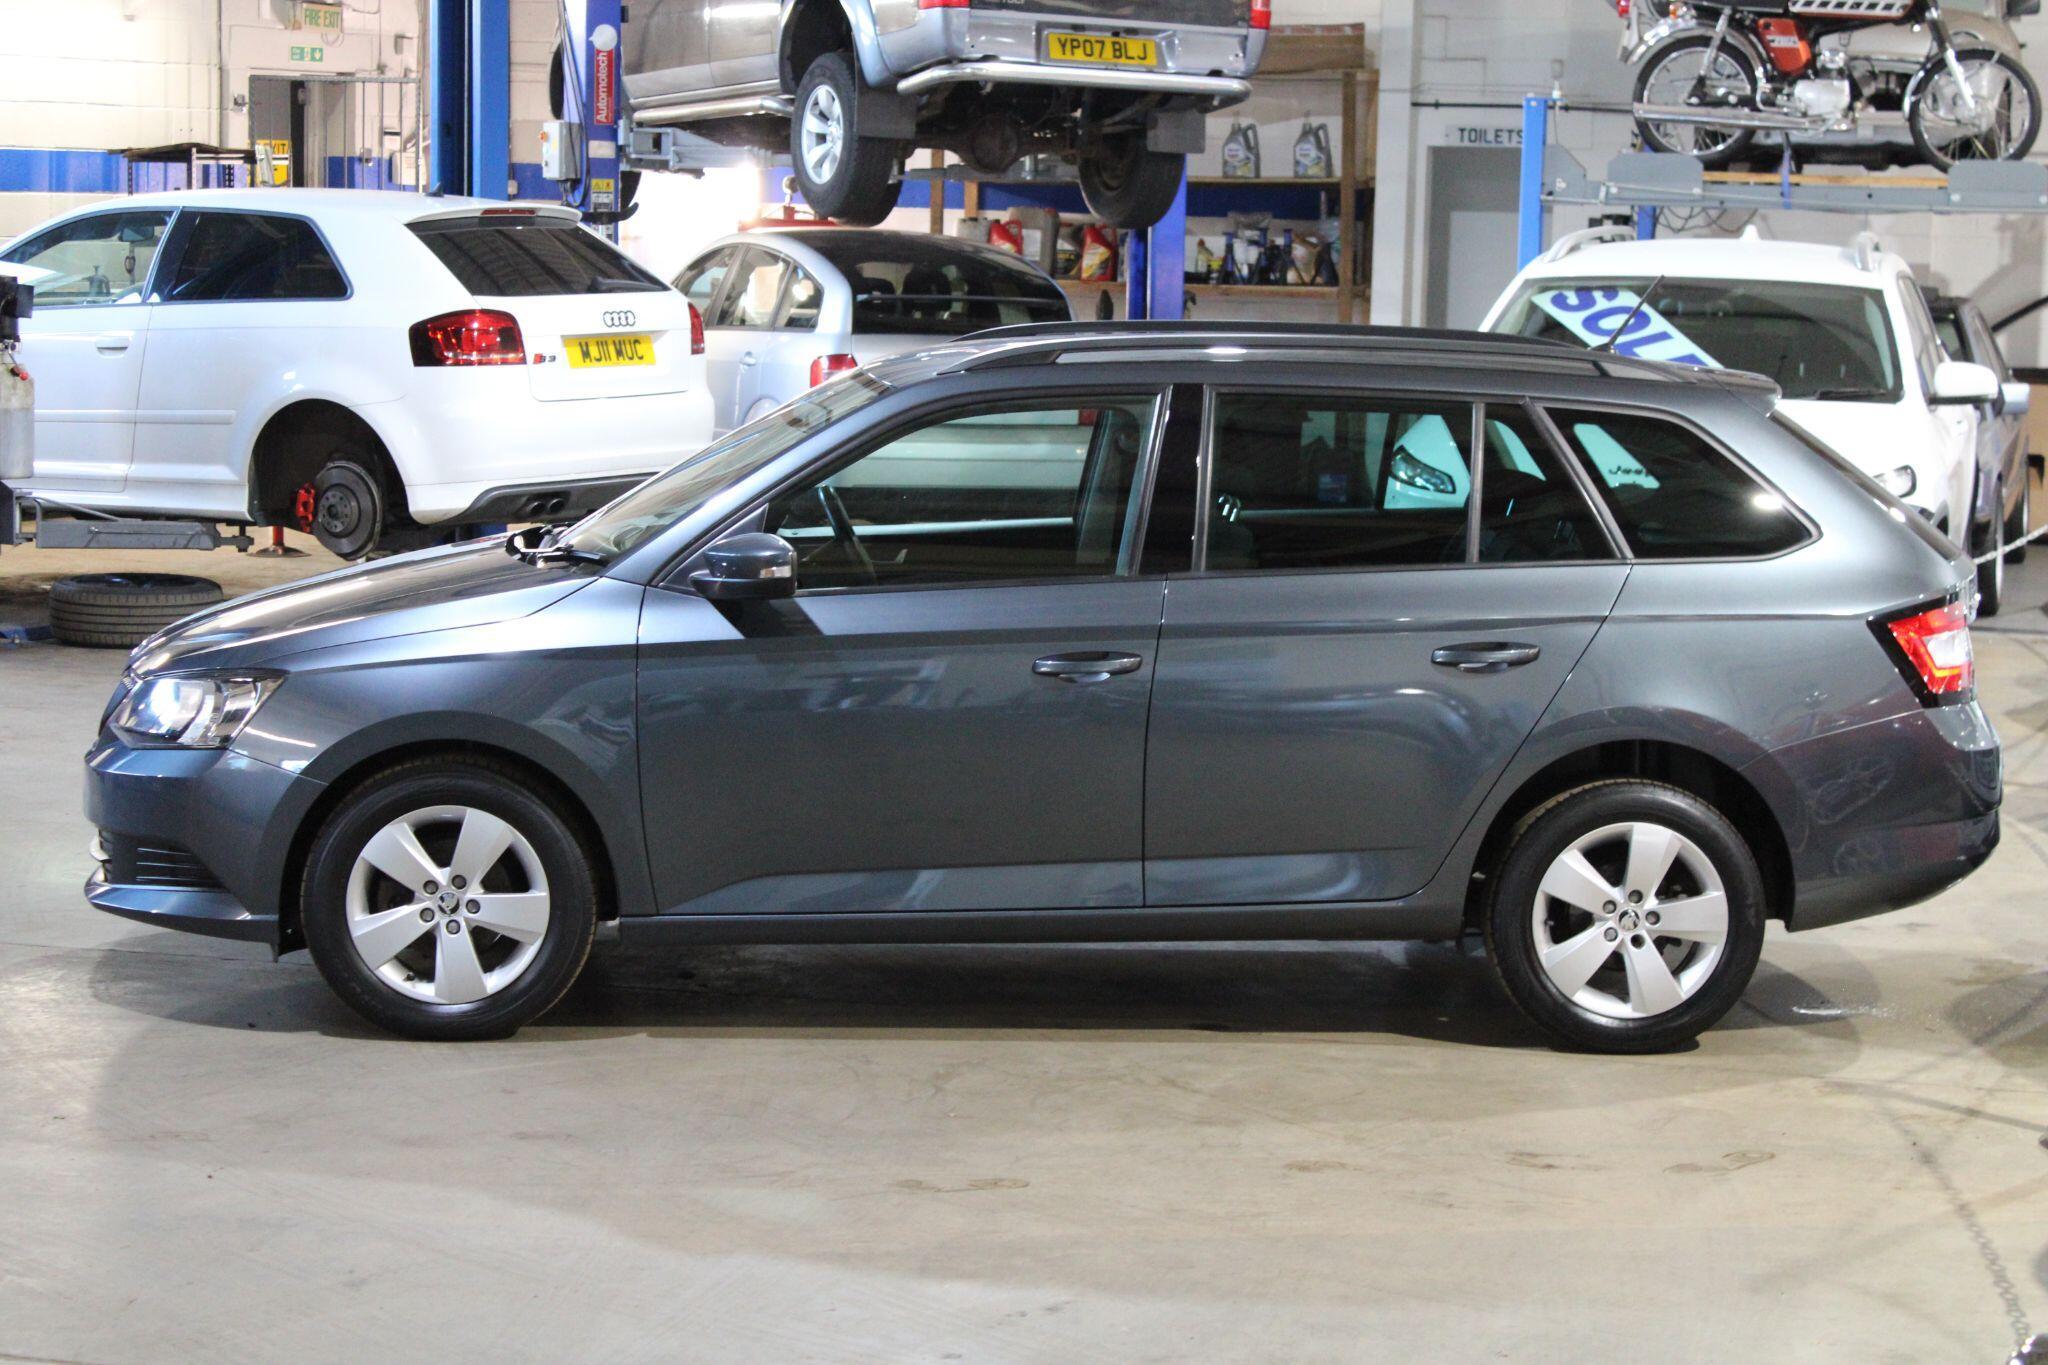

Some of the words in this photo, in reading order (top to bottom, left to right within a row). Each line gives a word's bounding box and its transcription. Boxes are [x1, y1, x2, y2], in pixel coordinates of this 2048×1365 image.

[304, 8, 321, 27] FIRE
[323, 10, 340, 29] EXIT
[1057, 37, 1105, 59] YP07
[1111, 41, 1148, 61] BLJ
[596, 52, 609, 122] Automotech
[1458, 127, 1523, 144] TOILETS
[1551, 286, 1709, 367] SOL
[578, 340, 611, 363] MJ11
[612, 338, 644, 362] MUC
